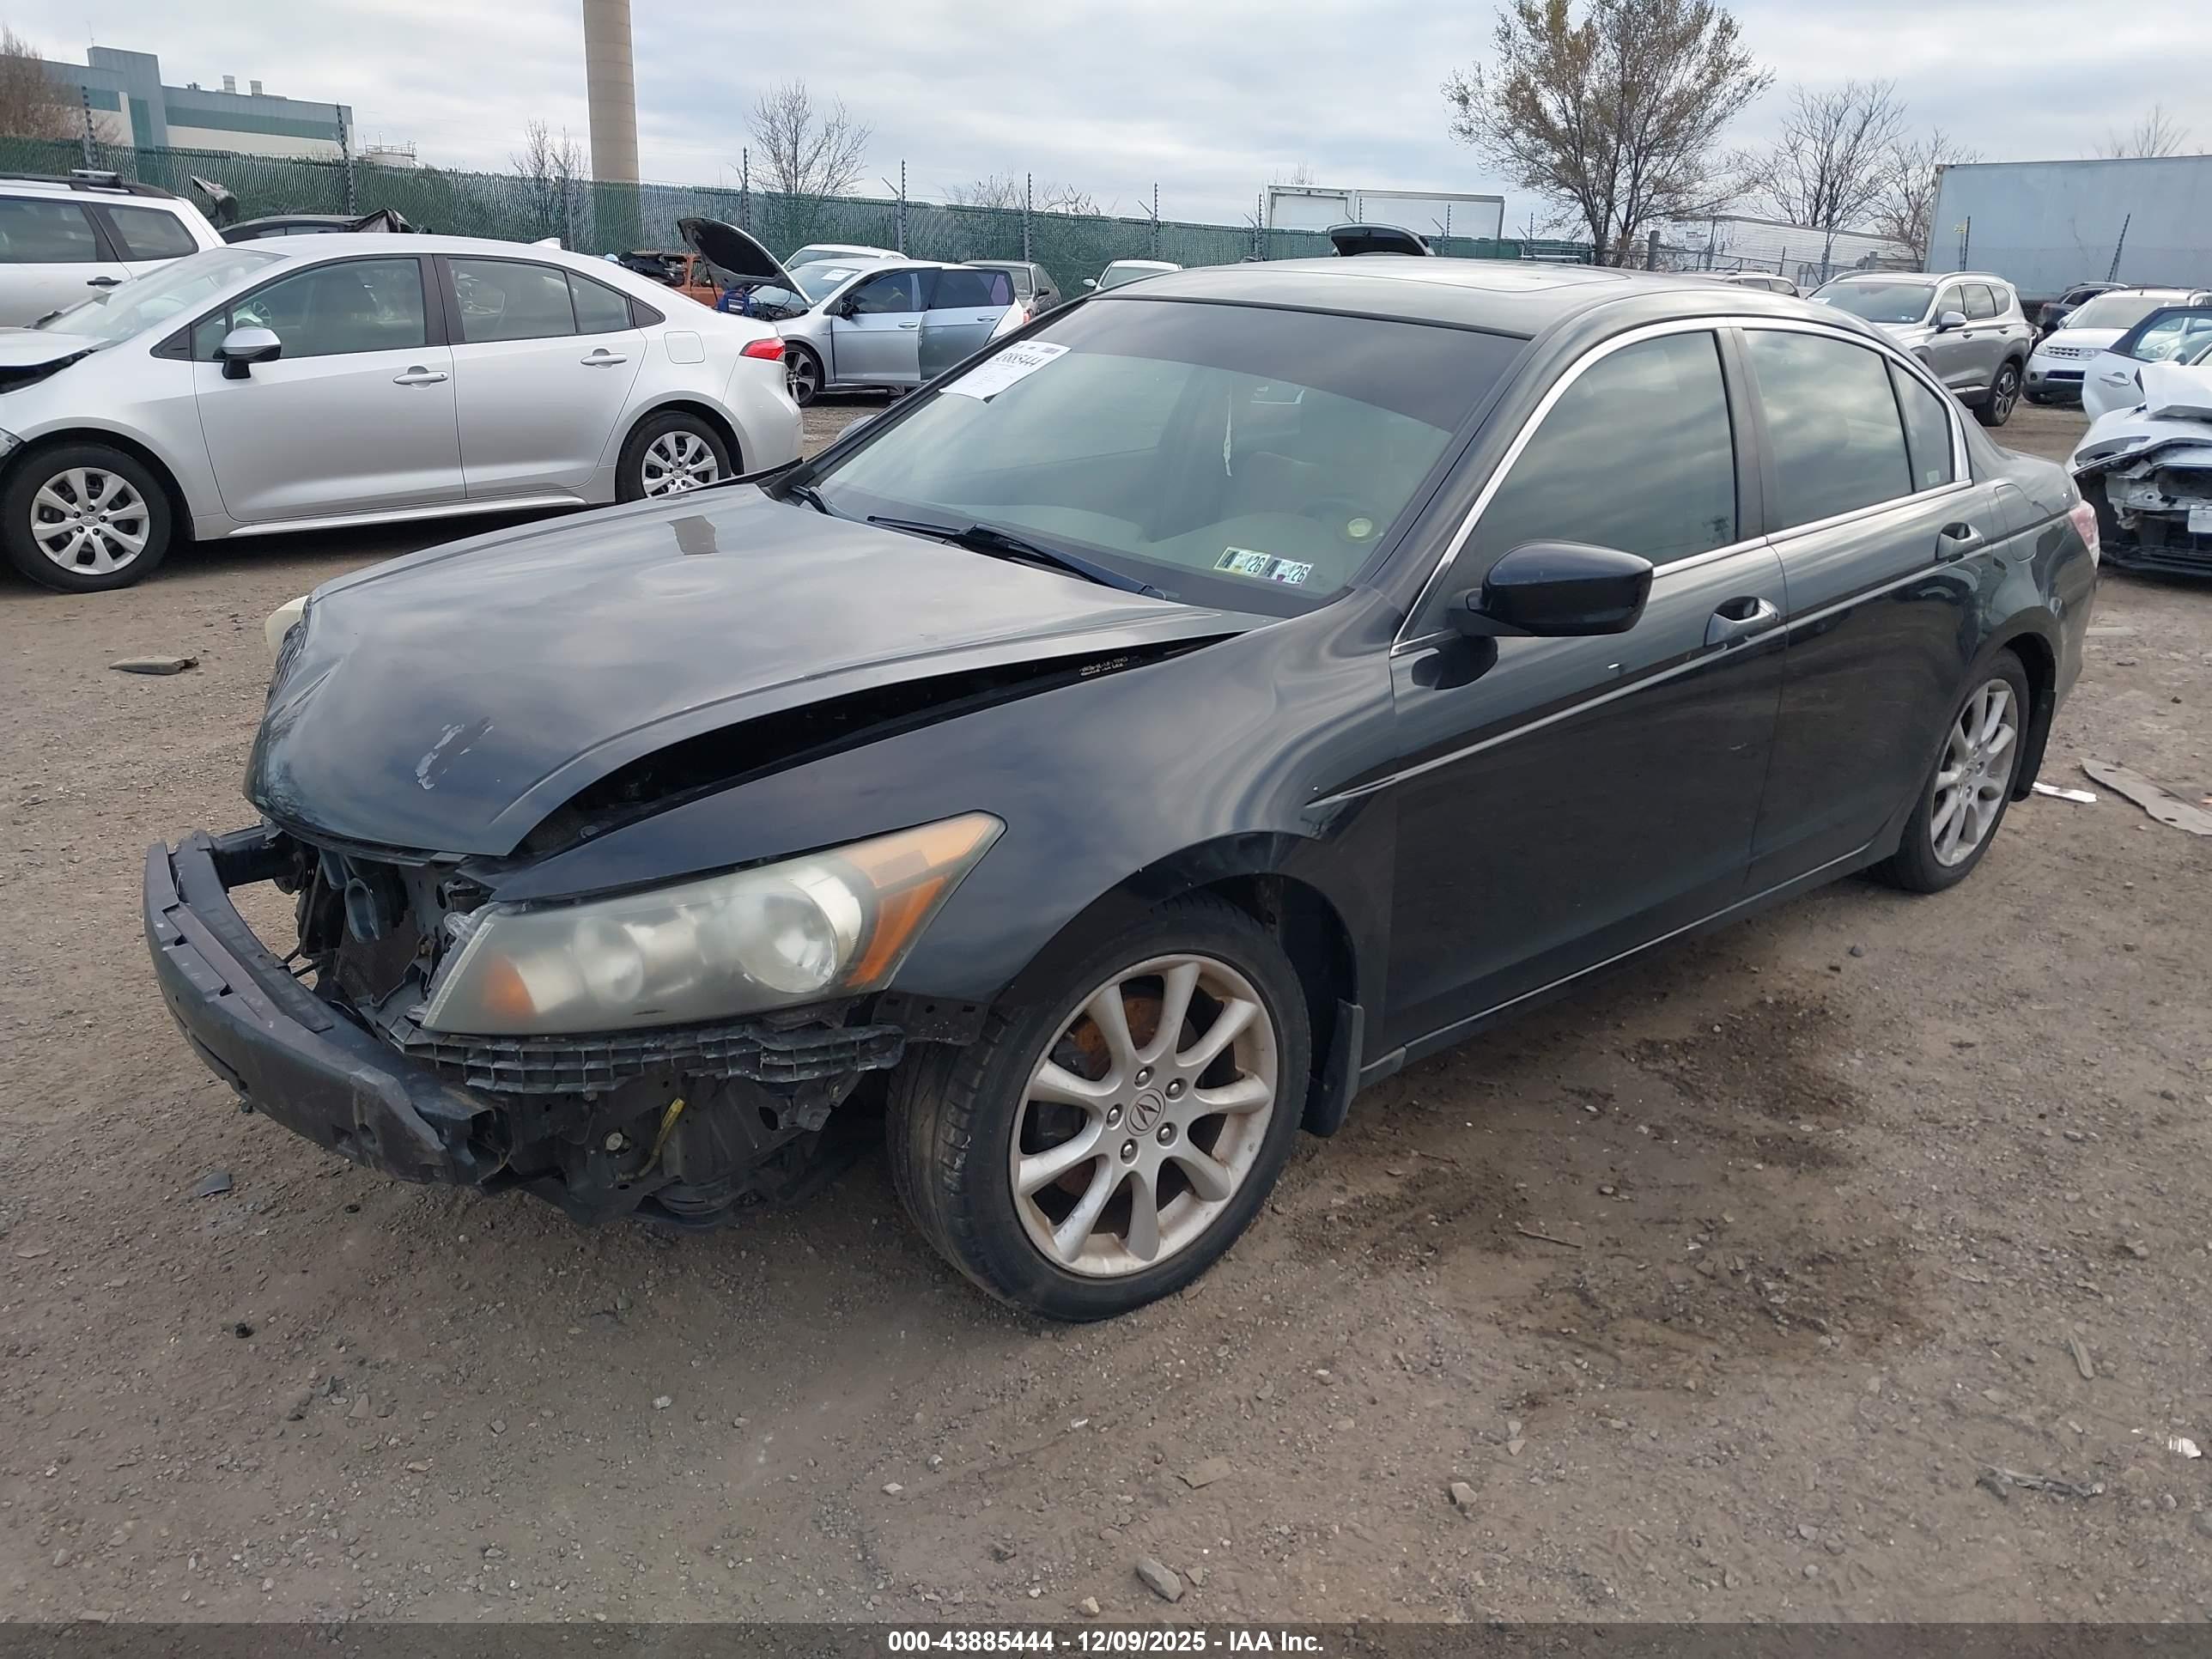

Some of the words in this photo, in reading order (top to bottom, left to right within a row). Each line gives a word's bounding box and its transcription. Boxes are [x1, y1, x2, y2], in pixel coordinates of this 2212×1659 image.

[1222, 551, 1238, 568] 4
[1247, 556, 1267, 573] 26
[1264, 560, 1281, 578] 4
[1291, 565, 1309, 583] 26
